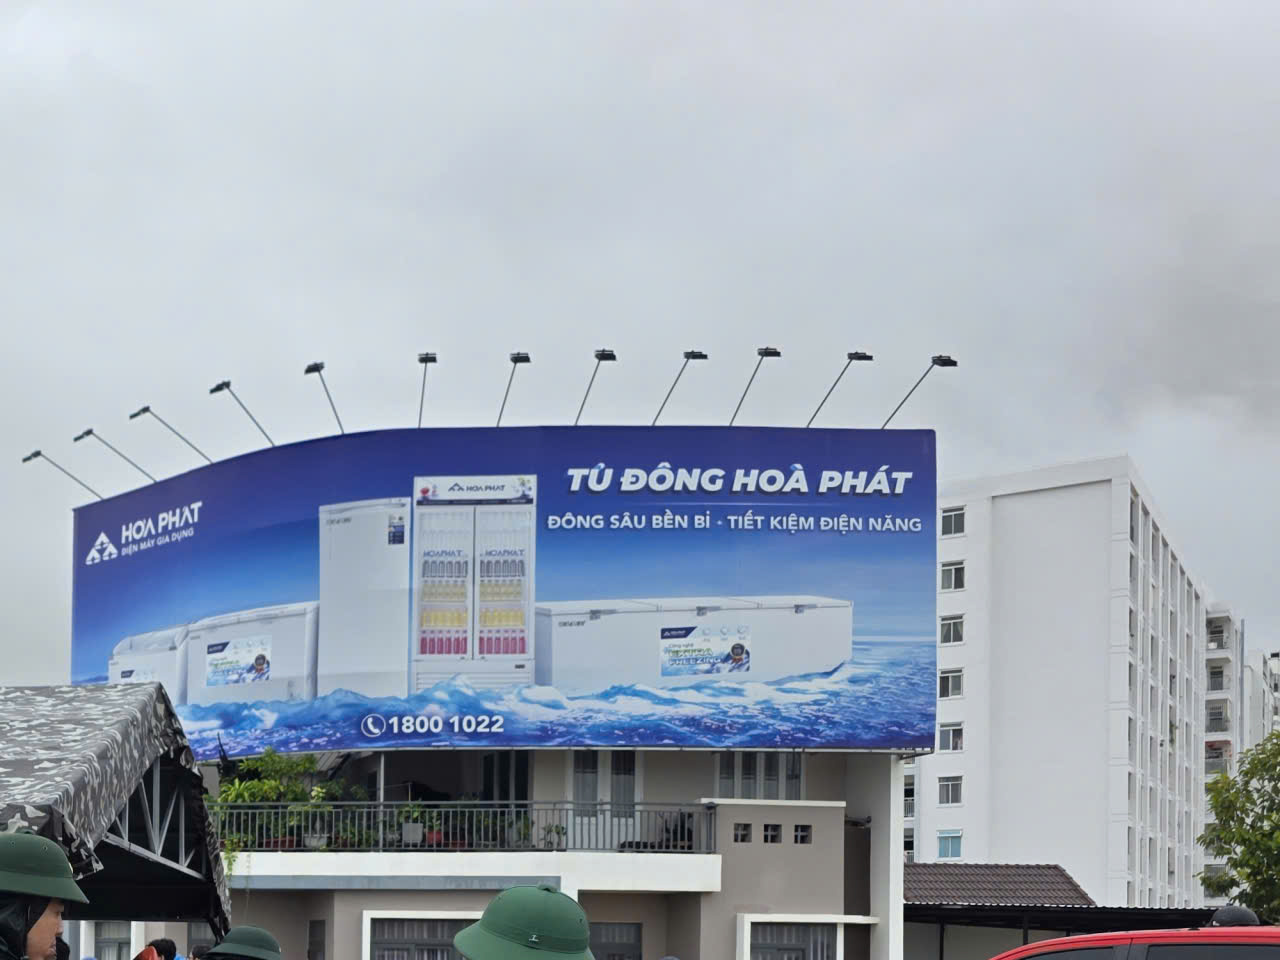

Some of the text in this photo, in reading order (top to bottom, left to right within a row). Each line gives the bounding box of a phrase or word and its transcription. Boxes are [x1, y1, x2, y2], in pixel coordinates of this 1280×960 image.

[567, 462, 914, 494] TỦ ĐÔNG HOÀ PHÁT
[547, 512, 604, 529] ĐÔNG
[610, 512, 646, 529] SÂU
[652, 509, 688, 529] BỀN
[727, 509, 765, 529] TIẾT
[770, 513, 815, 534] KIỆM
[820, 514, 863, 534] ĐIỆN
[869, 514, 922, 532] NĂNG
[388, 715, 504, 734] 1800 1022
